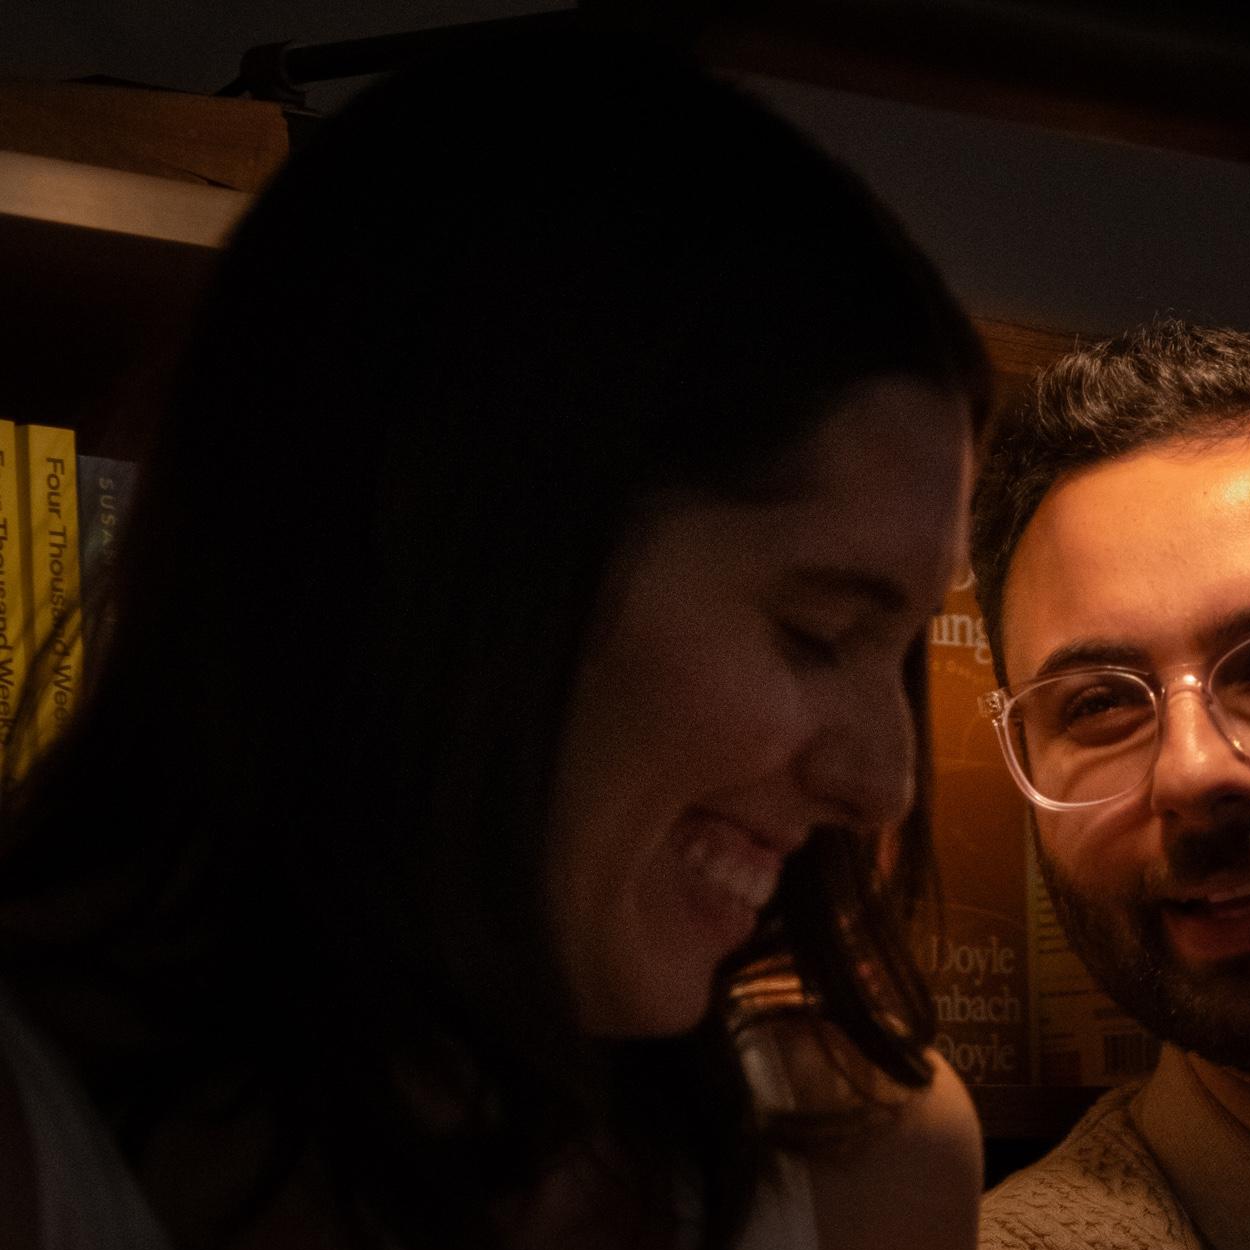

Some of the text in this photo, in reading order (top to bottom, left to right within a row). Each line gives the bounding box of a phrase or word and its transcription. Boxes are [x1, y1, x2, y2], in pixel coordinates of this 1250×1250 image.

[46, 457, 65, 519] Four
[48, 525, 69, 656] Thousad
[929, 934, 1016, 986] Doyle
[934, 1032, 1017, 1083] Doyle
